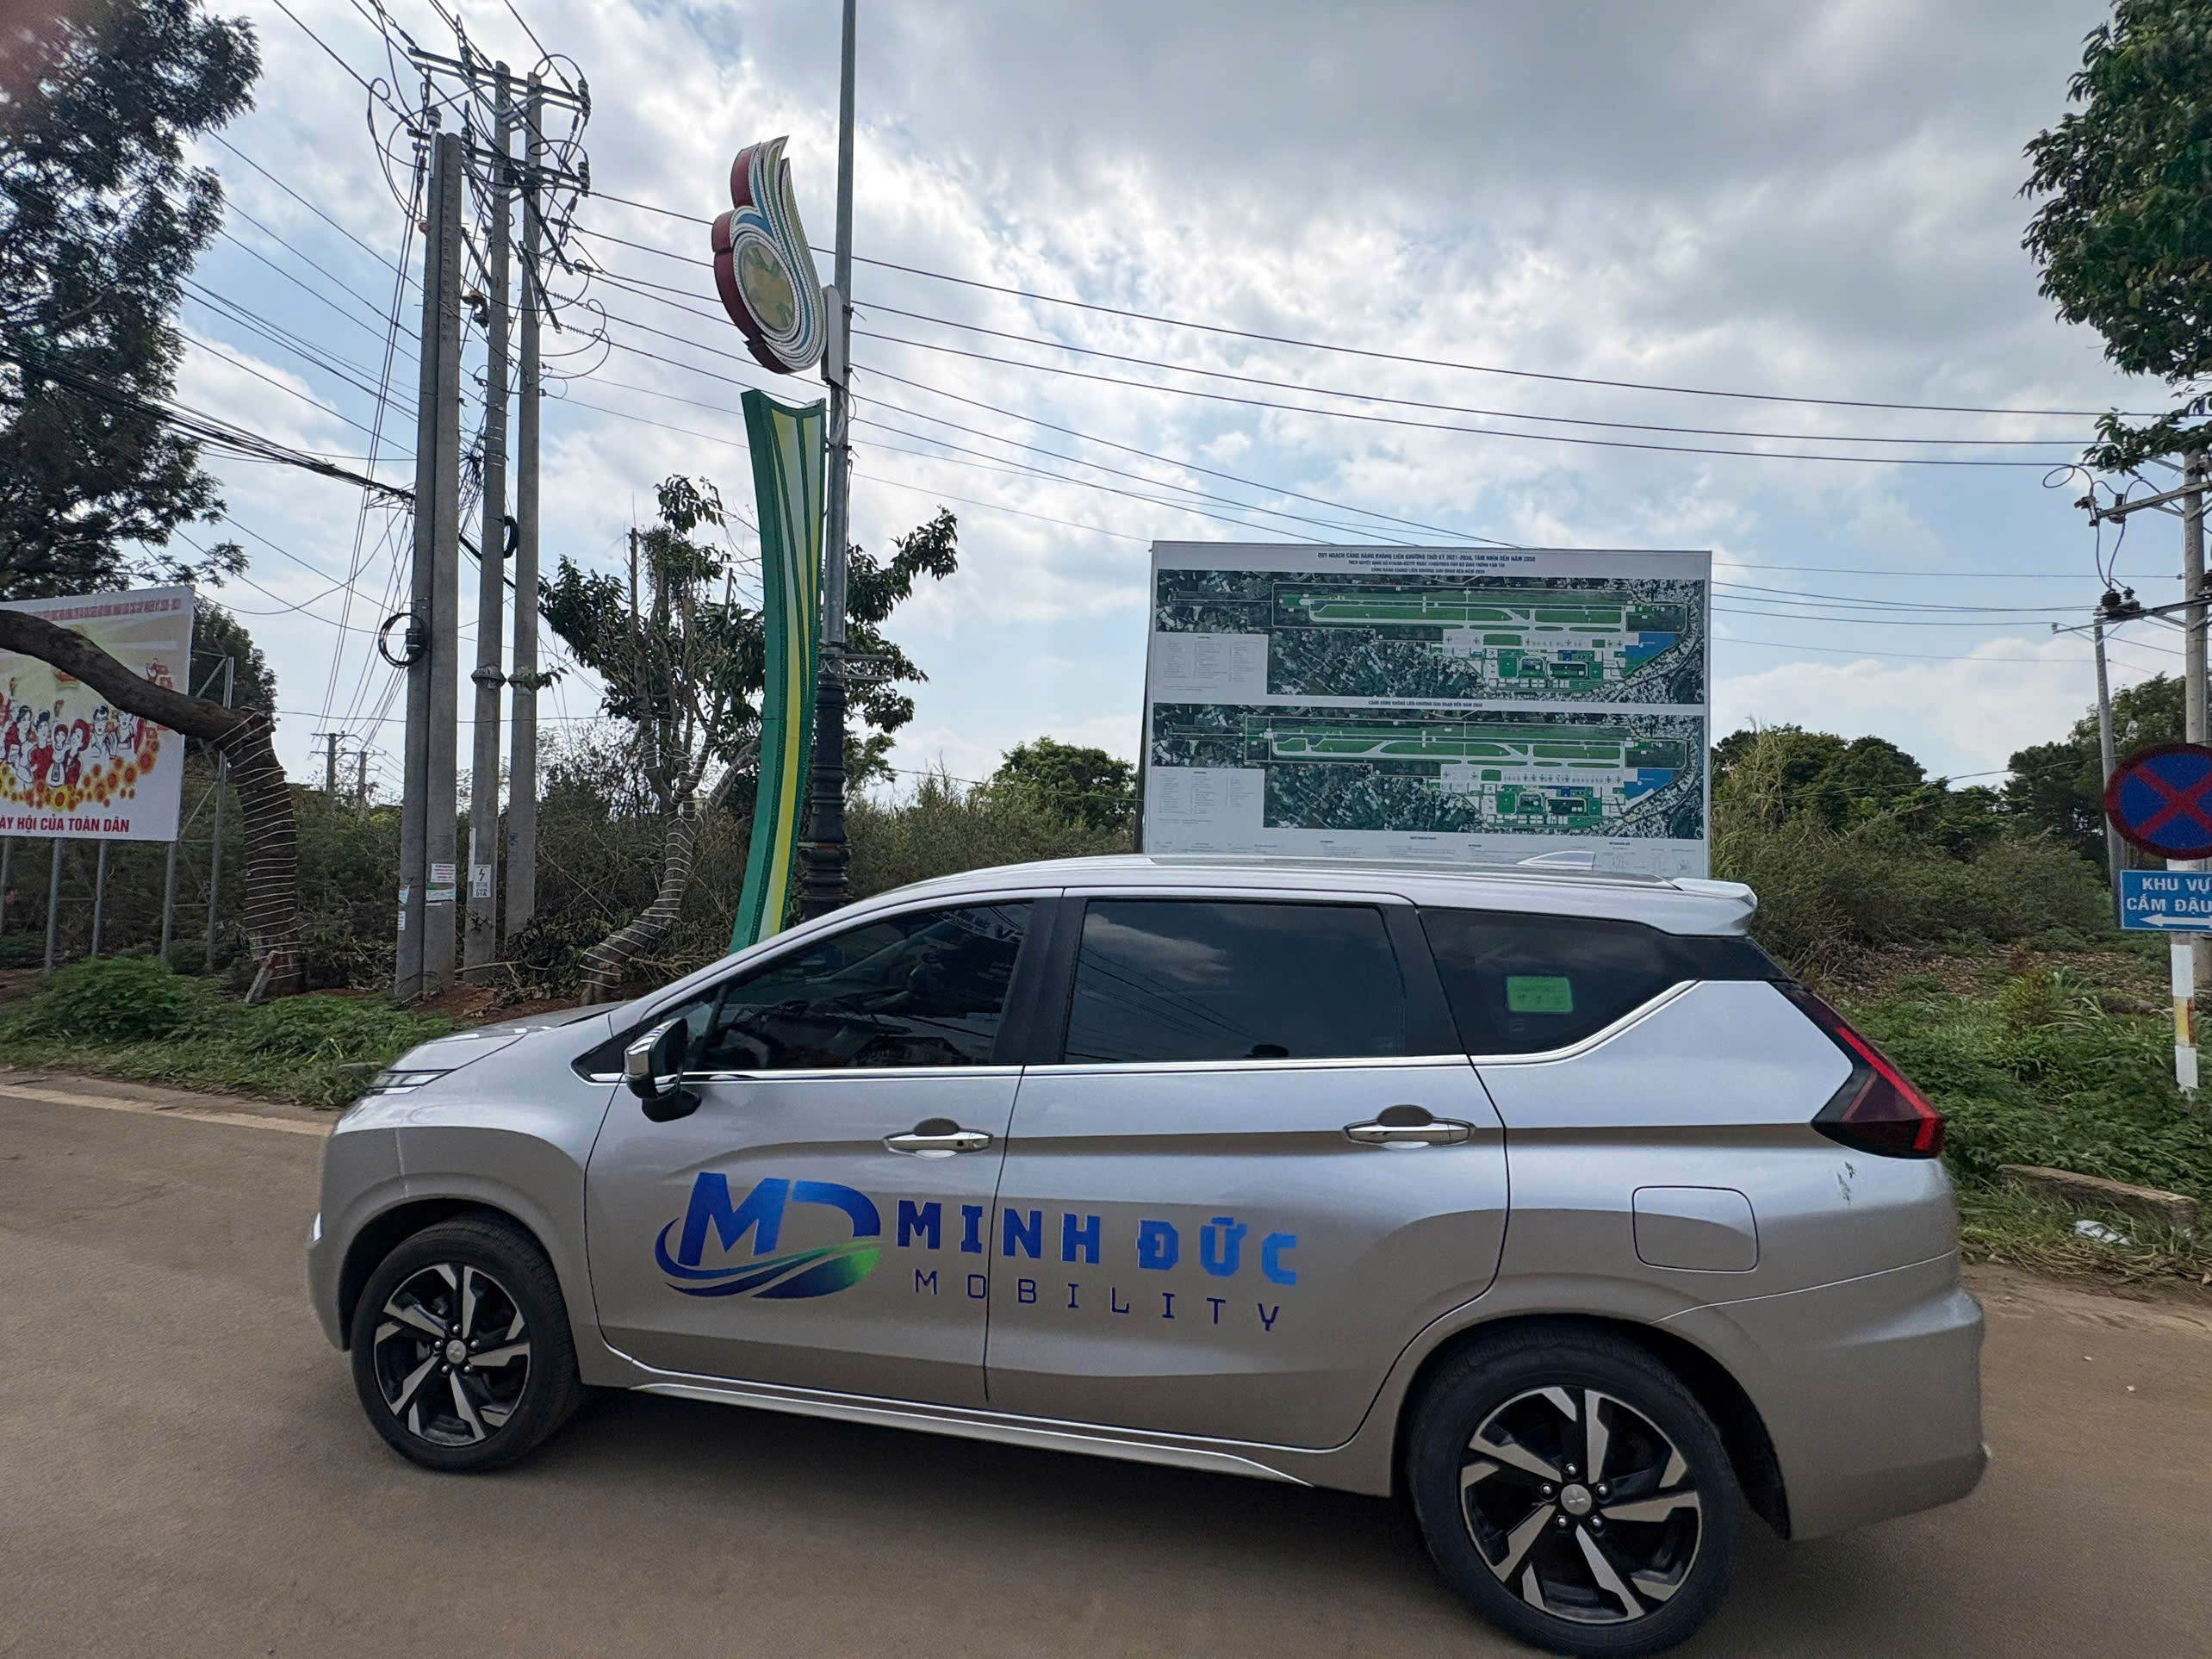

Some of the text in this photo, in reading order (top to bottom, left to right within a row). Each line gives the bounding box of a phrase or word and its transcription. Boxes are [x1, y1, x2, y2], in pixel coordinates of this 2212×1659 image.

[0, 813, 130, 833] ÀY HỘI CỦA TOÀN DÂN
[2142, 877, 2212, 894] KHU VỰ
[2126, 893, 2166, 912] CẤM
[896, 1199, 1297, 1285] MINH ĐỨC
[914, 1269, 1280, 1332] MOBILITY
